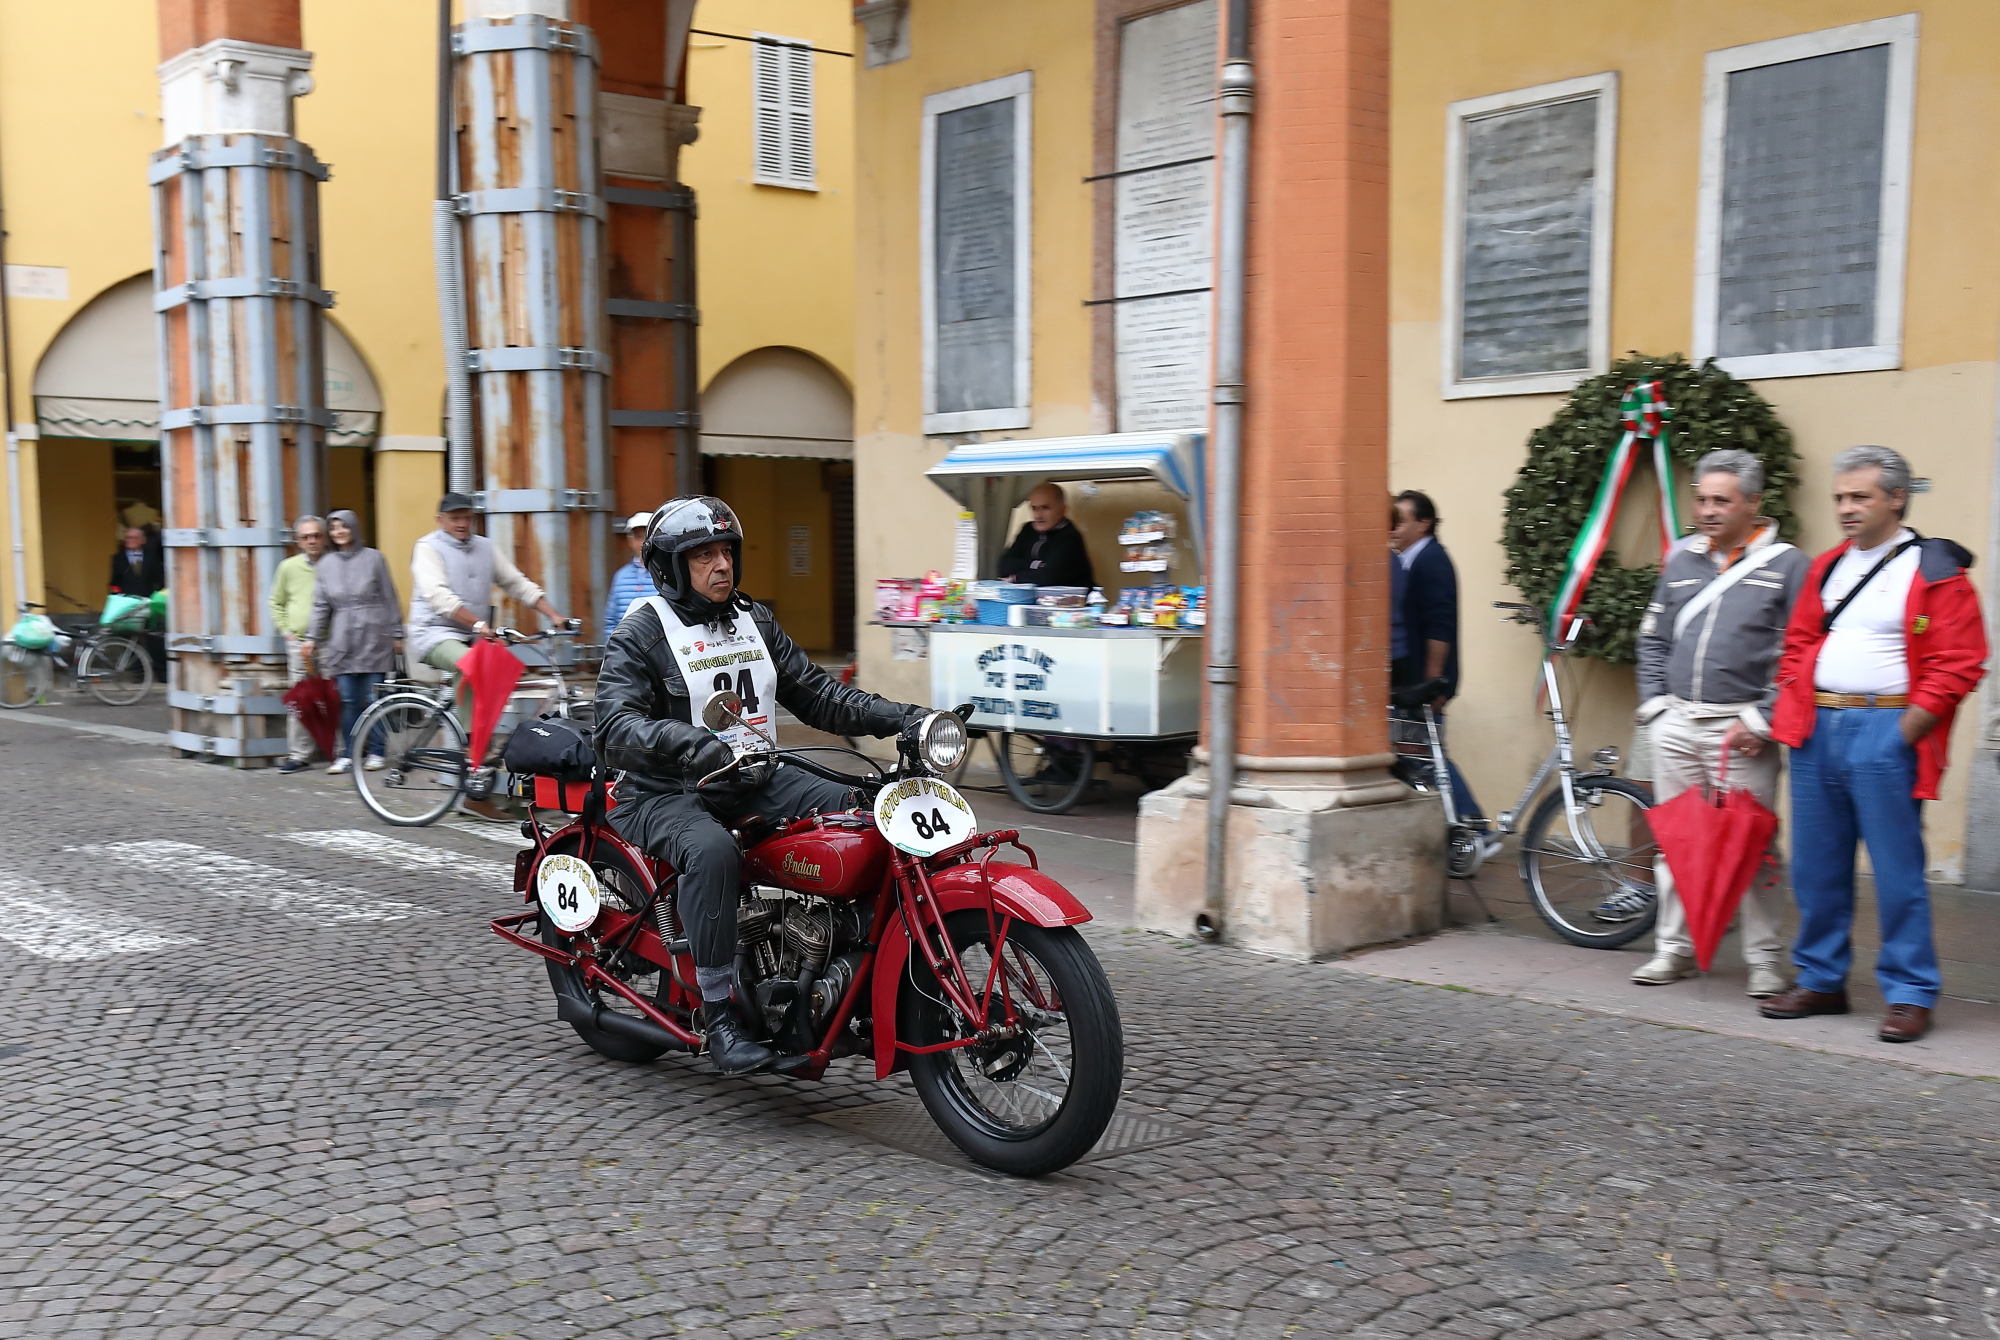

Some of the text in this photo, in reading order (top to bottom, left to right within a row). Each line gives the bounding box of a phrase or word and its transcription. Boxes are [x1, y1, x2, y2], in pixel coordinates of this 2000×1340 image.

[688, 649, 765, 672] MOTOGIRO D'ITALIA
[879, 779, 970, 832] MOTOGIRO D'ITALIA
[911, 807, 951, 840] 84
[782, 850, 821, 877] Indian
[557, 883, 579, 913] 84
